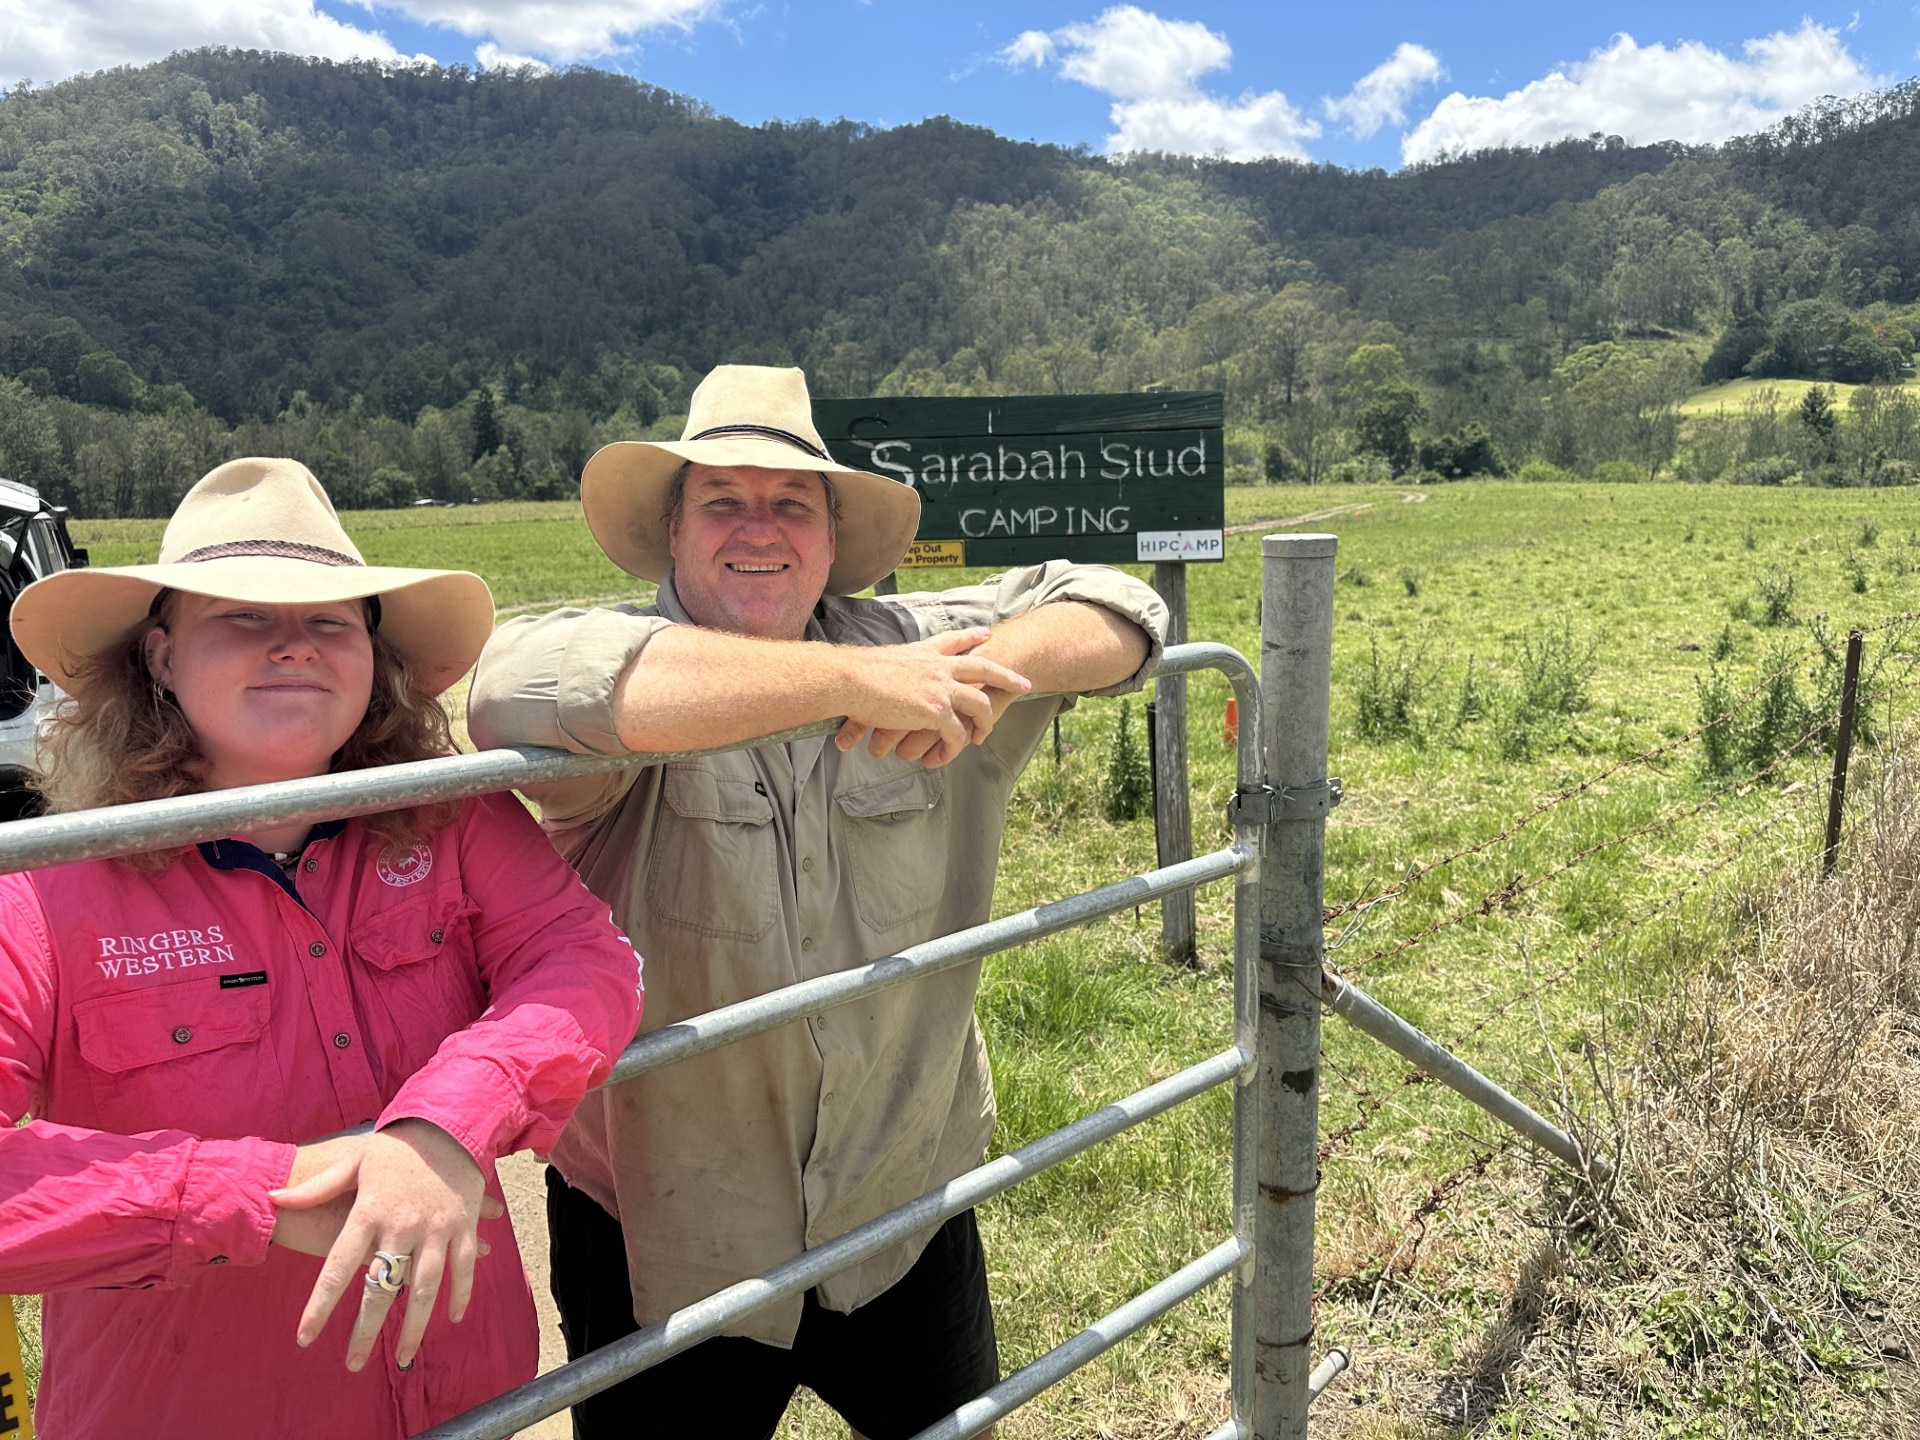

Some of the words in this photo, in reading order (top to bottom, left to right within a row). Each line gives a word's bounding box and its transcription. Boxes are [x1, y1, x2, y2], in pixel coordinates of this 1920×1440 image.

[871, 440, 1086, 487] Sarabah
[1101, 433, 1207, 480] Stud
[960, 506, 1131, 537] CAMPING
[908, 546, 921, 555] ep
[923, 544, 942, 553] Out
[916, 554, 959, 565] Property
[1140, 539, 1220, 552] HIPCAMP
[386, 860, 430, 885] WESTERN
[97, 925, 224, 957] RINGERS
[95, 944, 235, 979] WESTERN
